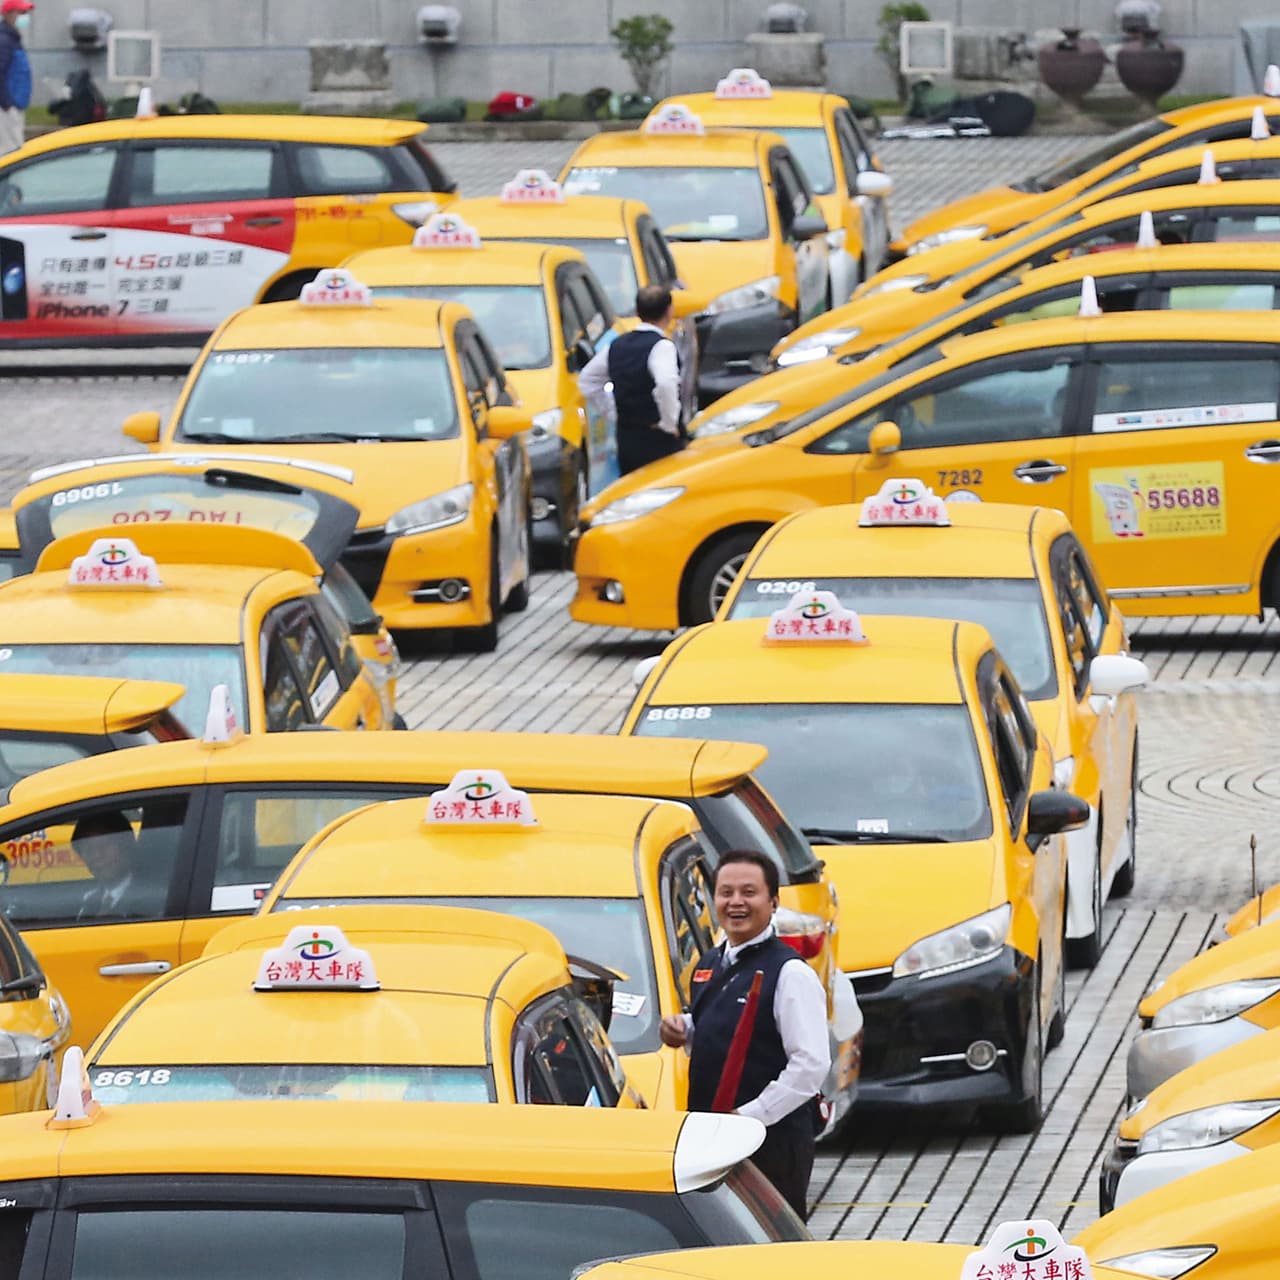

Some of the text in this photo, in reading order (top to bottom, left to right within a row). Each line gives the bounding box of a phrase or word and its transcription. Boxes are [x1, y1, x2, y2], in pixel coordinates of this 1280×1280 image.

[37, 300, 110, 318] iPhone
[936, 469, 984, 486] 7282
[1147, 486, 1220, 511] 55688
[867, 504, 939, 521] 台灣大車隊
[75, 565, 150, 582] 台灣大車隊
[774, 619, 853, 636] 台灣大車隊
[646, 706, 712, 721] 8688
[433, 801, 523, 820] 台灣大車隊
[265, 959, 366, 983] 台灣大車隊
[94, 1068, 171, 1087] 8618
